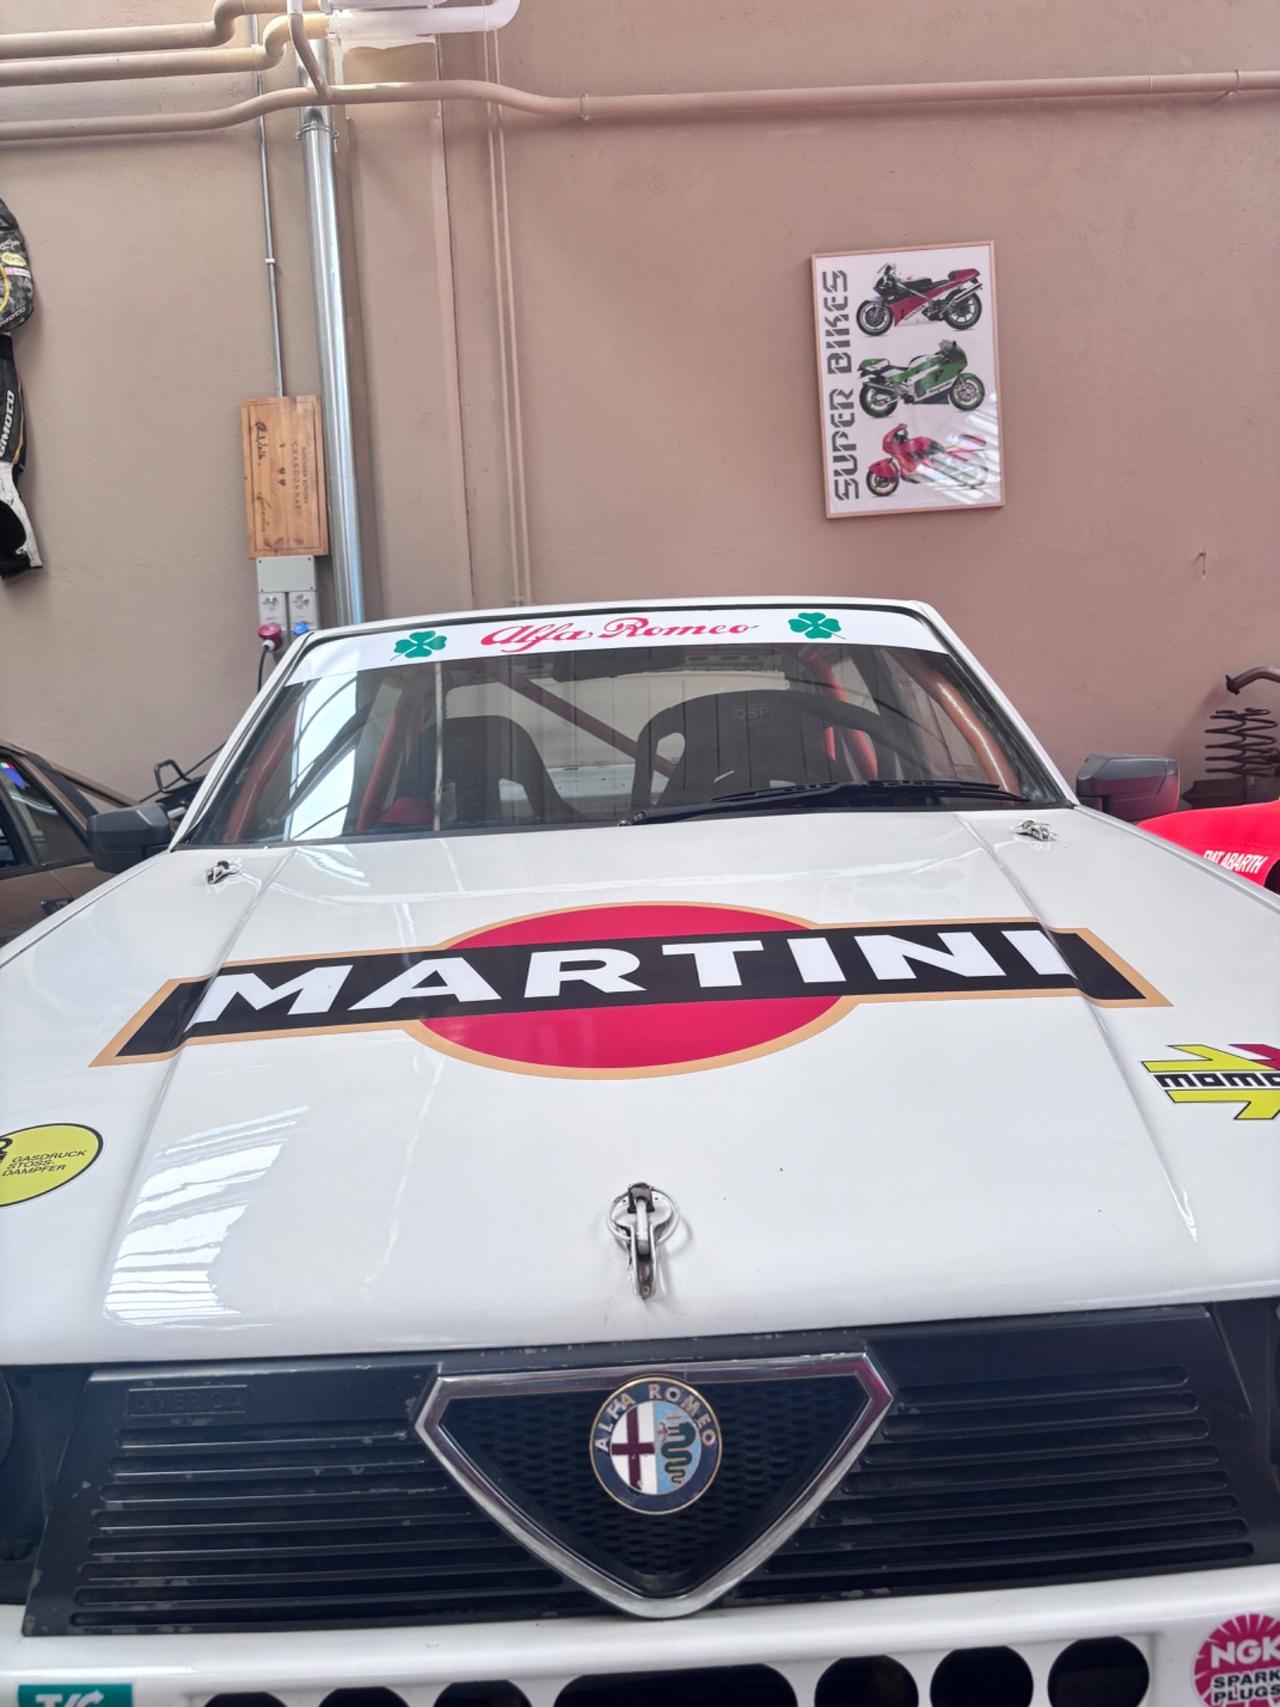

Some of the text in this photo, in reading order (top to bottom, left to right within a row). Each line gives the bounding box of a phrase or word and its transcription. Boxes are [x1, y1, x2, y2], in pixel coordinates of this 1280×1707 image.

[822, 269, 859, 500] SUPER BIKES
[481, 617, 757, 652] Alfa Romeo
[1220, 852, 1269, 874] ABARTH
[184, 930, 1078, 1032] MARTINI
[12, 1149, 87, 1163] GASDRUCK
[595, 1383, 716, 1454] ALFA ROMEO
[1210, 1635, 1280, 1668] NGK
[1213, 1669, 1280, 1688] SPARK
[1213, 1684, 1280, 1703] PLUGS
